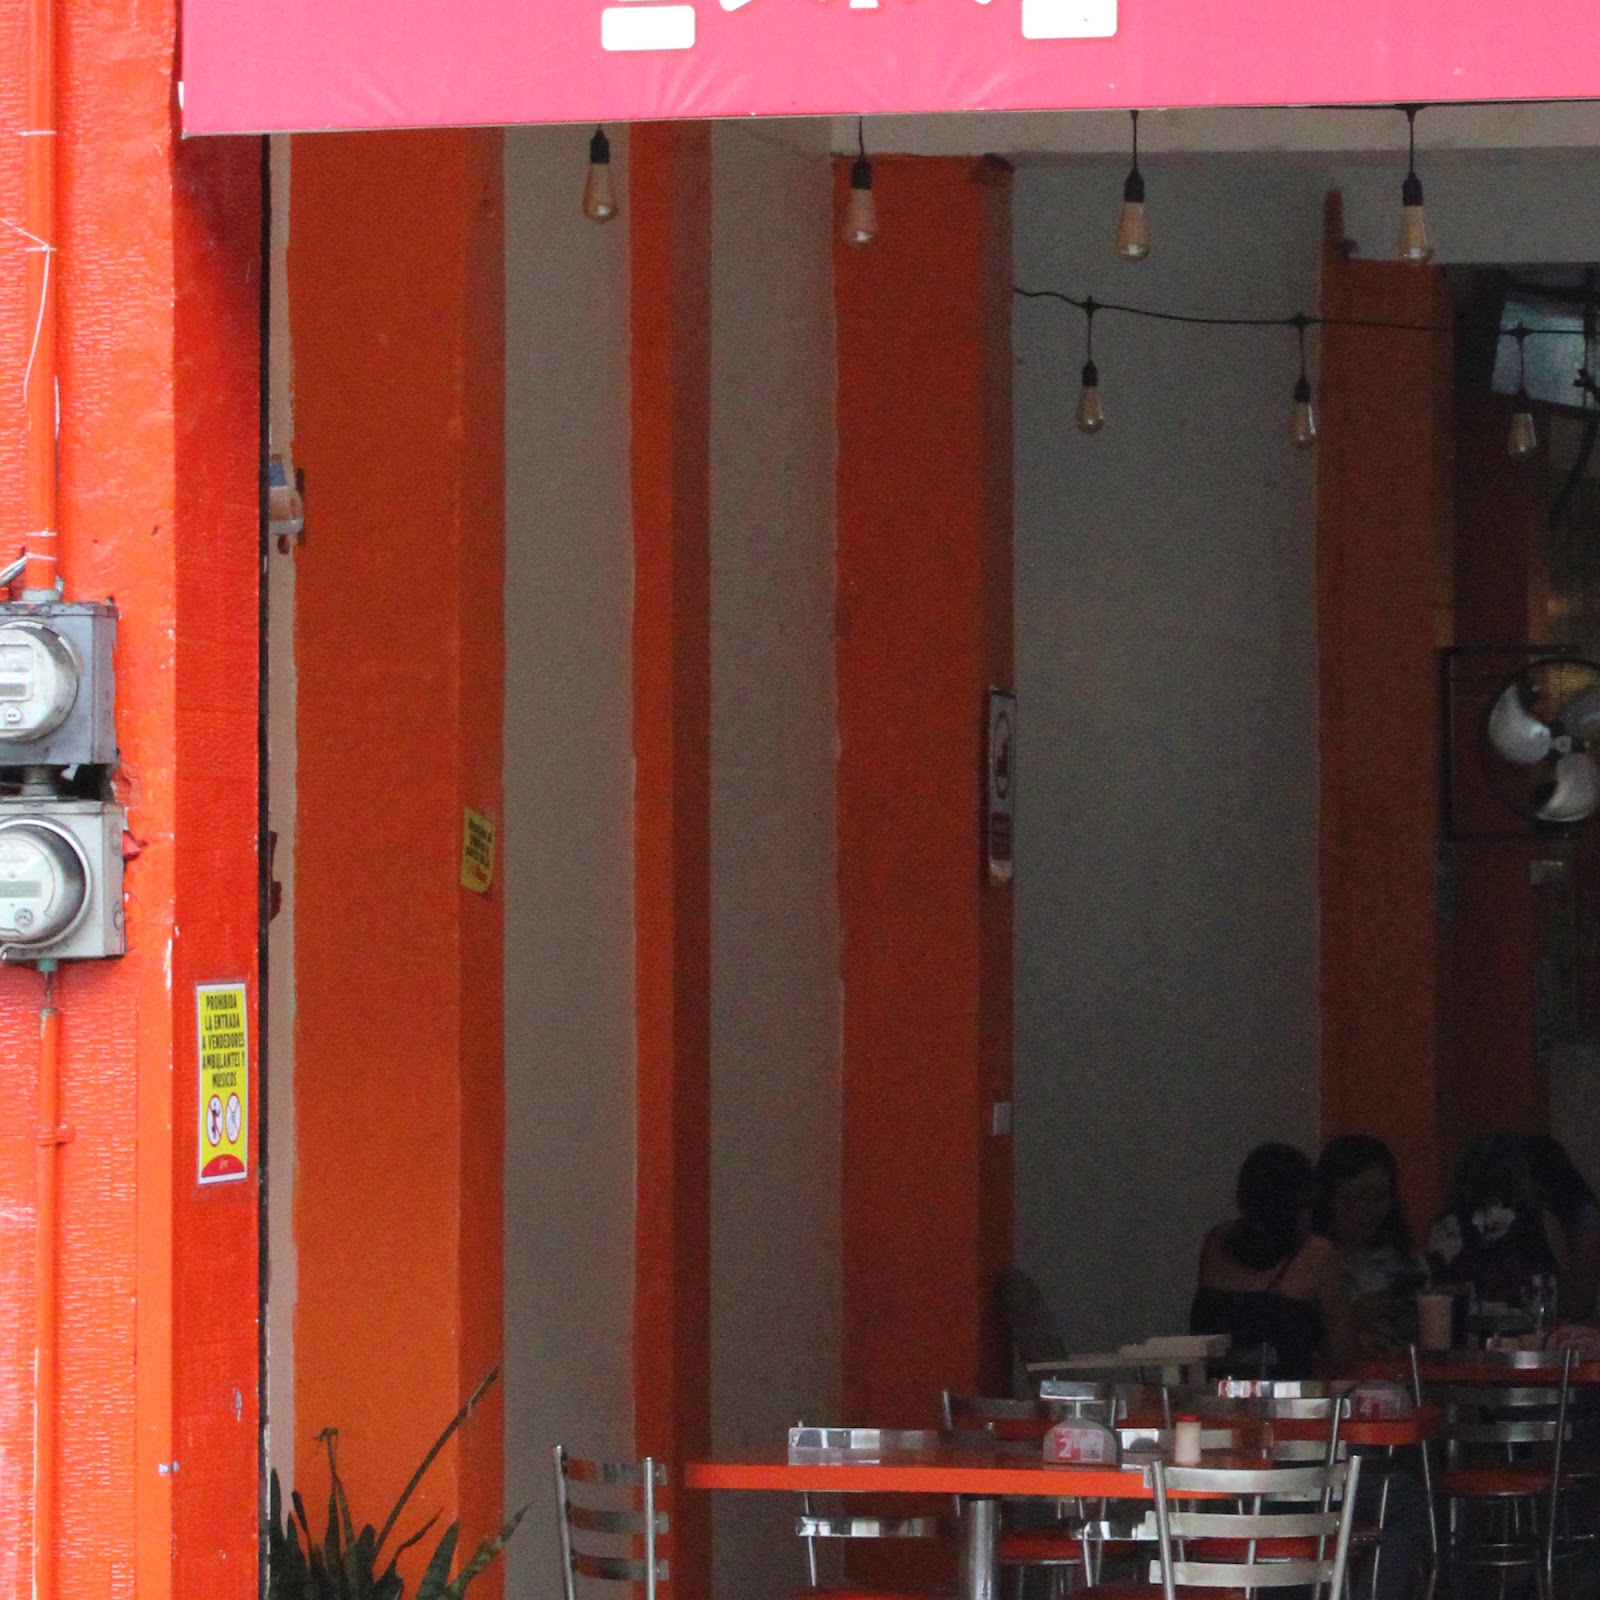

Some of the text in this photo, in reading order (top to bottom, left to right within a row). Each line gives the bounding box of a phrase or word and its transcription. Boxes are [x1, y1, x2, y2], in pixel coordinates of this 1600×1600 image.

[205, 993, 237, 1010] PROHIBIDA
[205, 1012, 240, 1031] LA ENTRADA
[208, 1031, 245, 1050] VENDEDORES
[1058, 1437, 1072, 1458] 2
